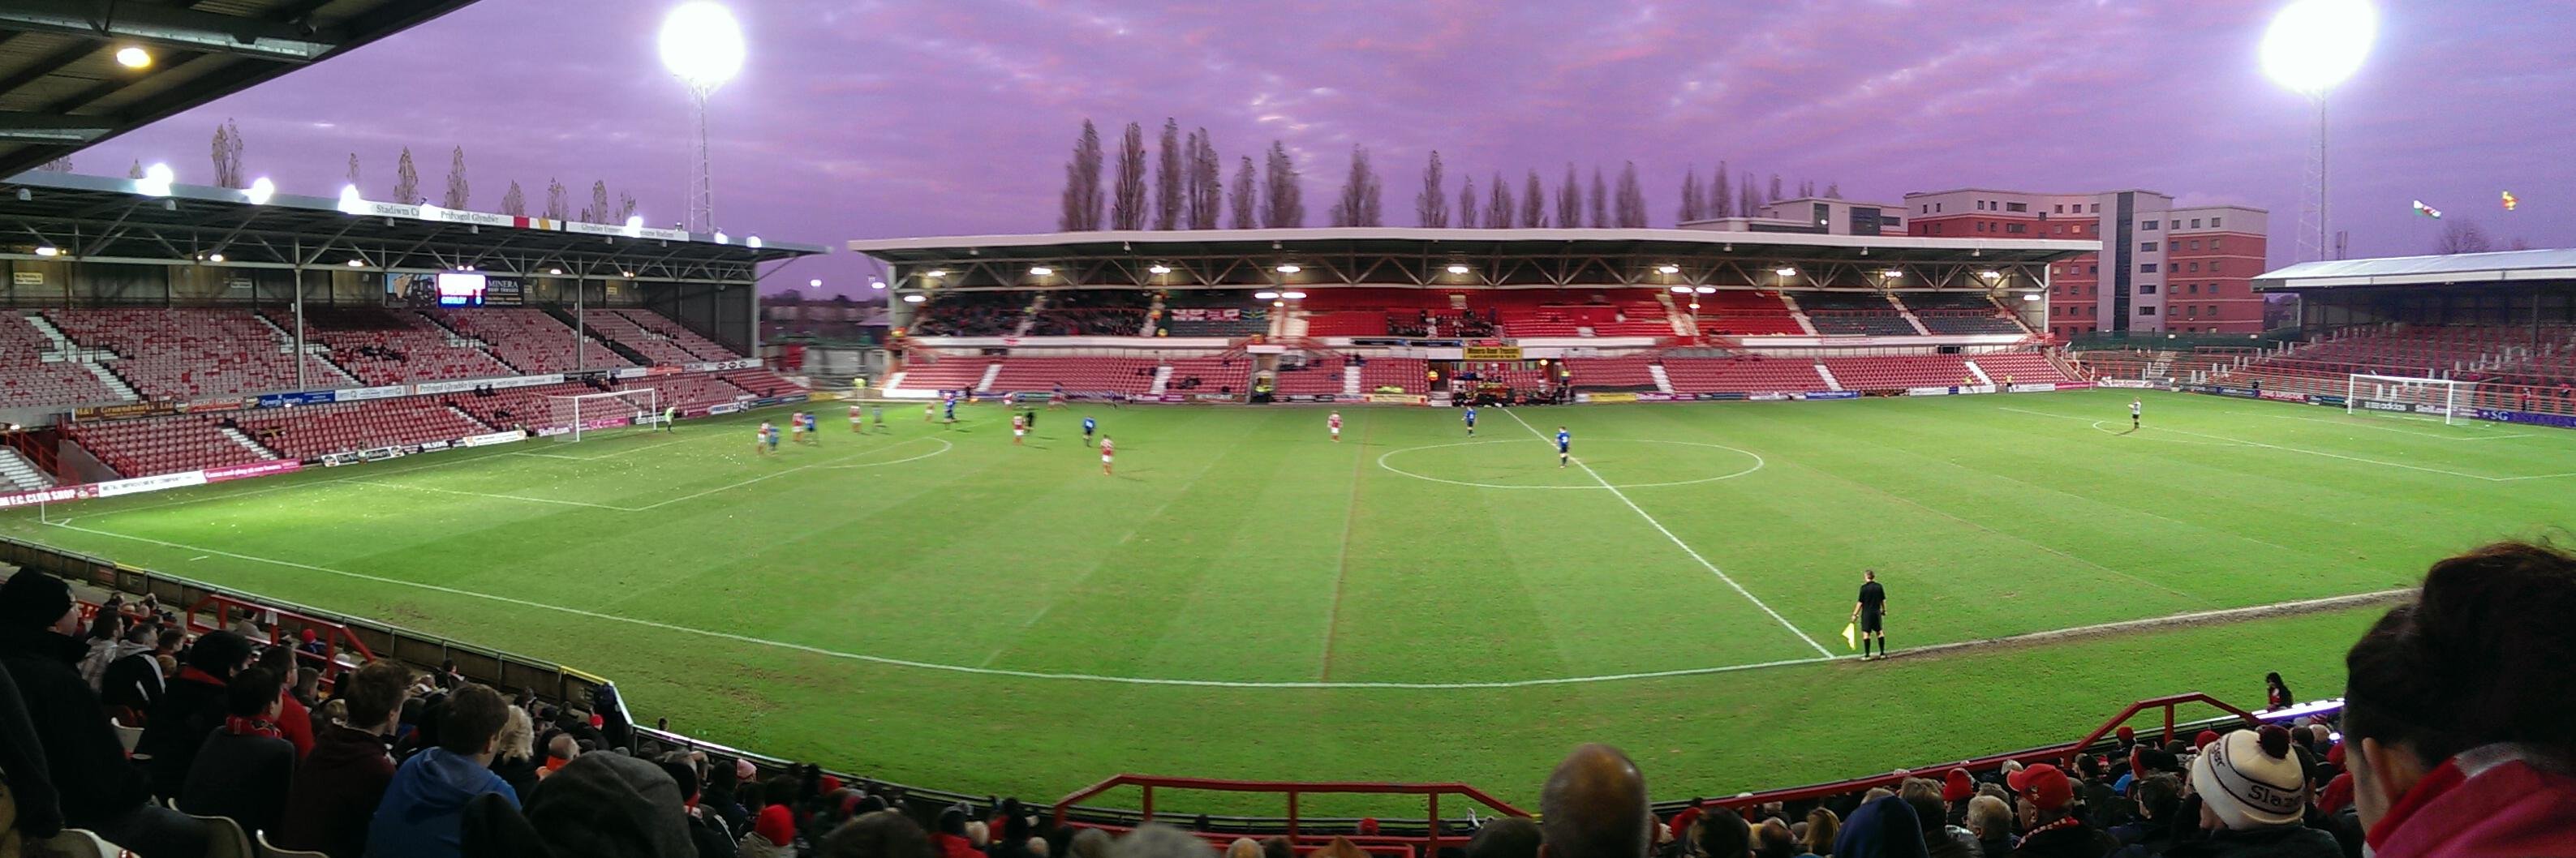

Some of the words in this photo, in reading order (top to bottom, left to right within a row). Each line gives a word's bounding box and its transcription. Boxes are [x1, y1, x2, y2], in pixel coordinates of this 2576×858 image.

[488, 280, 518, 288] MINERA
[25, 492, 51, 503] CLUB
[52, 489, 76, 500] SHOP
